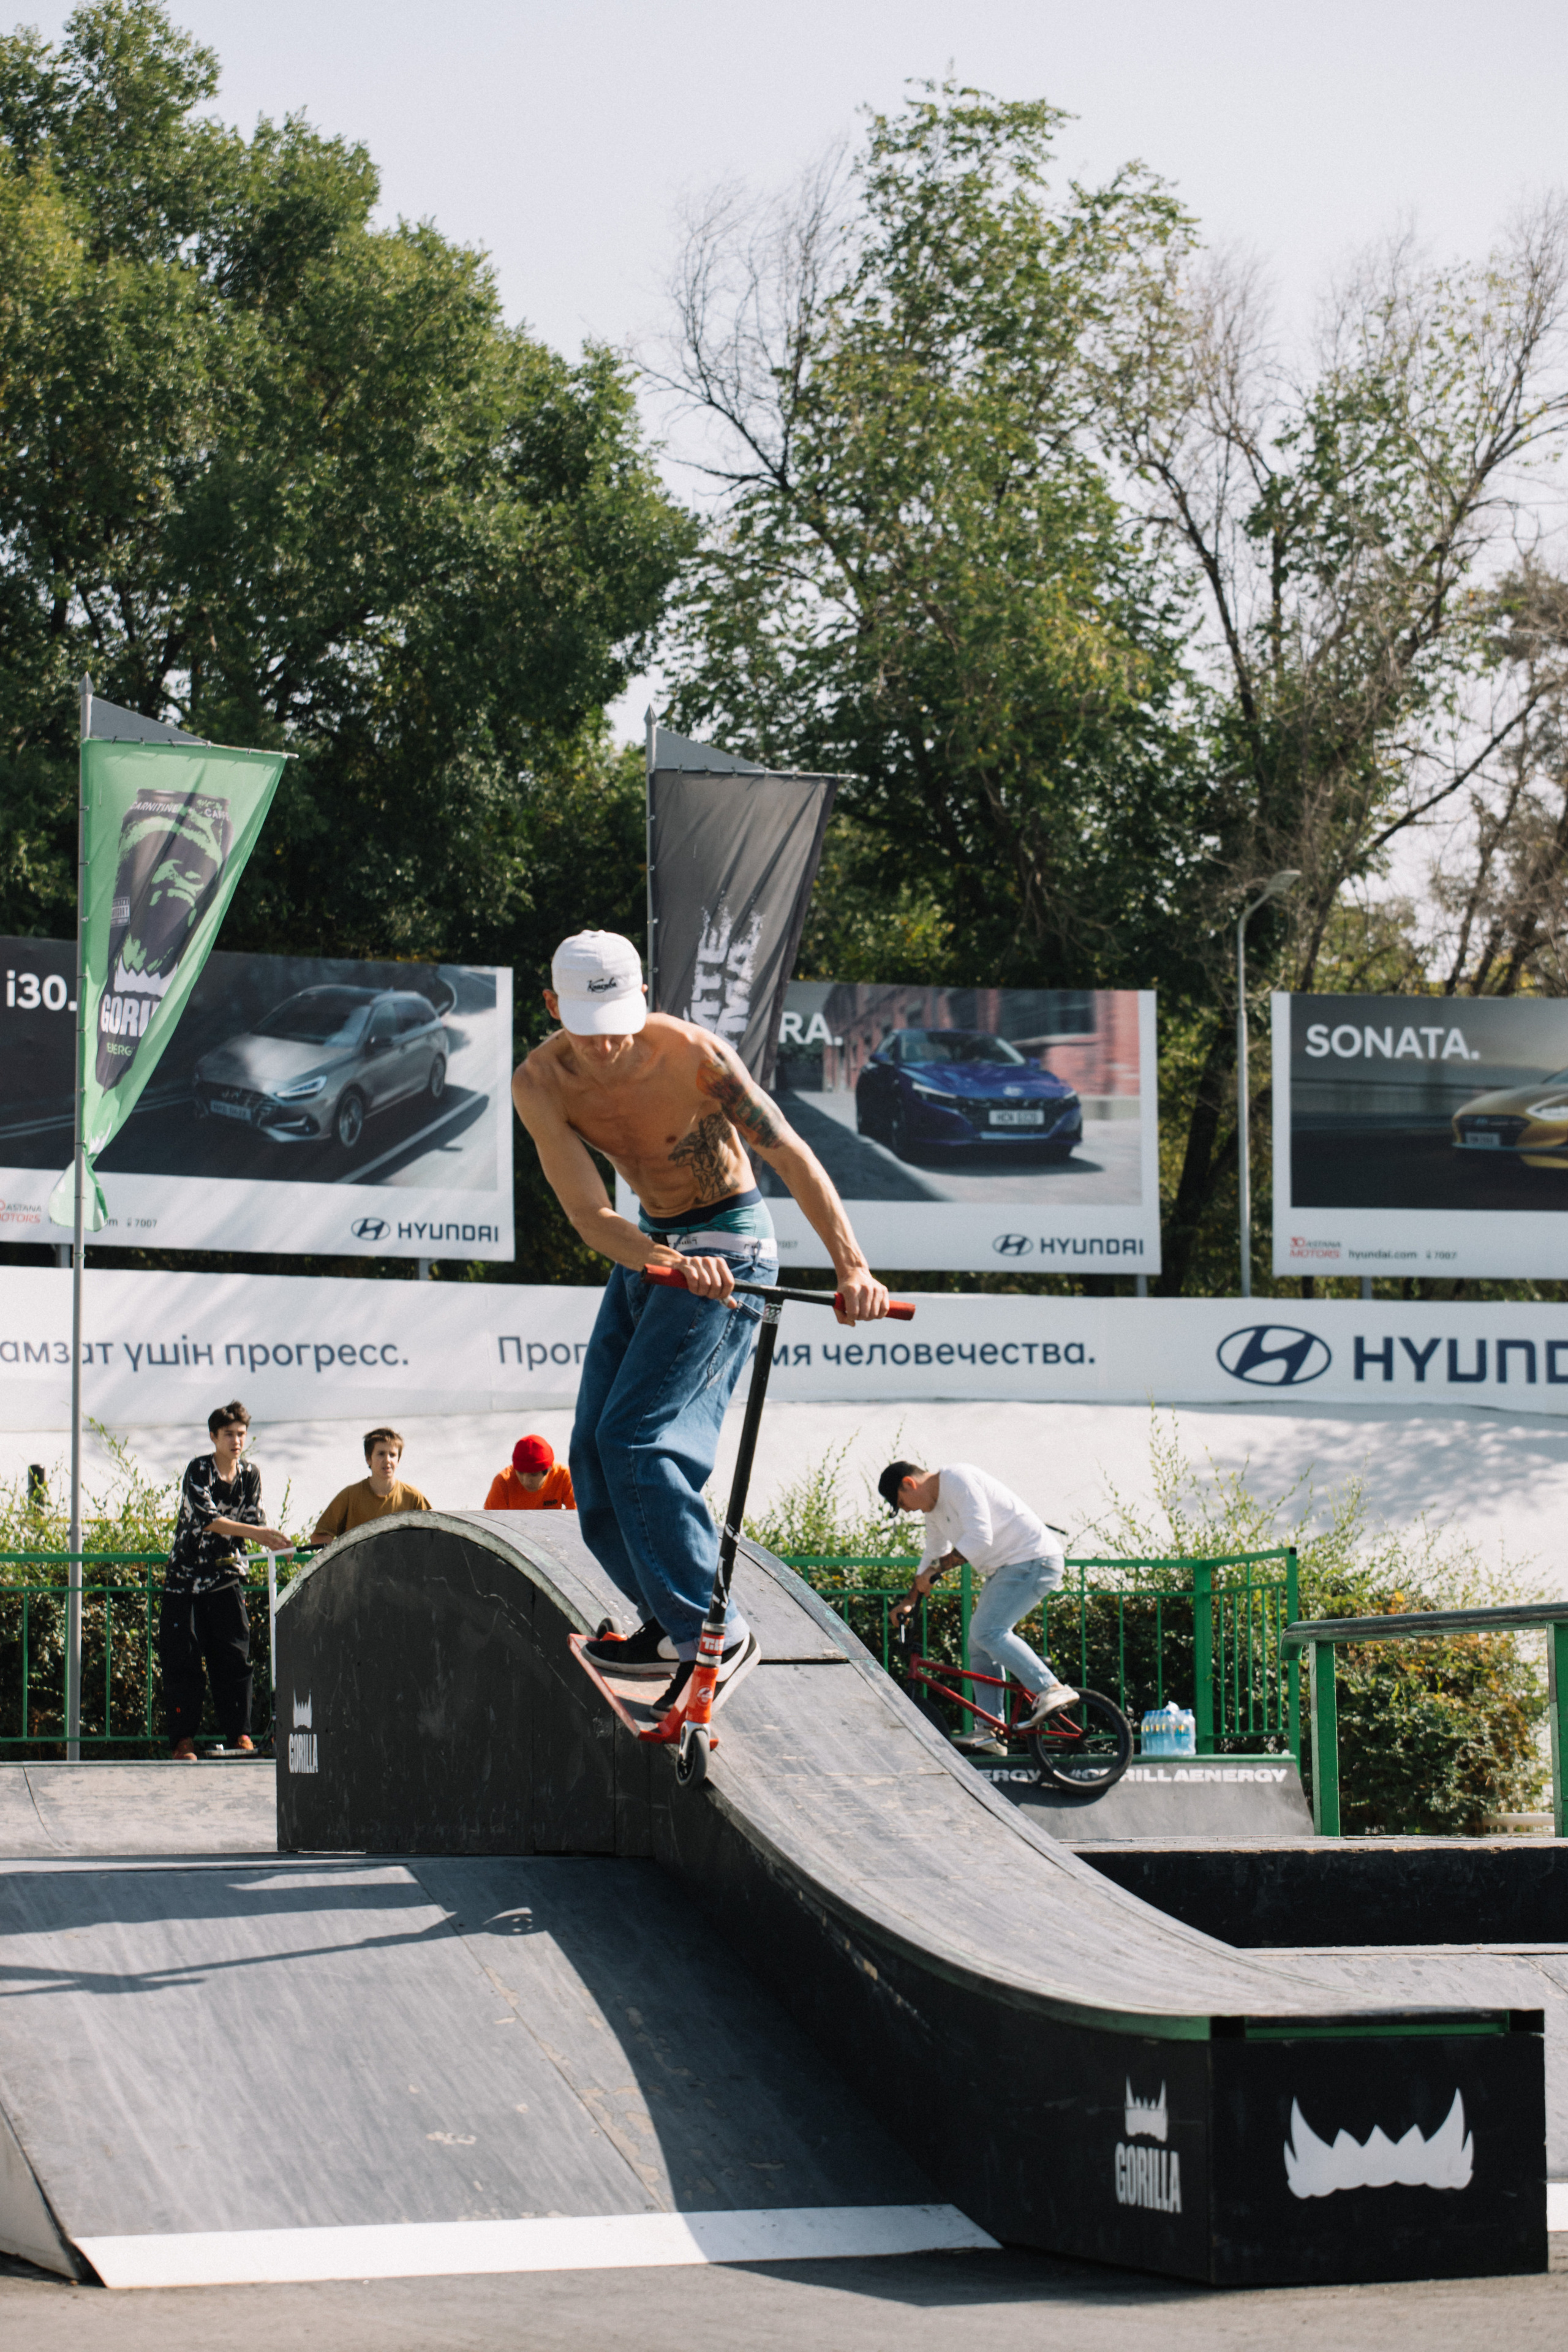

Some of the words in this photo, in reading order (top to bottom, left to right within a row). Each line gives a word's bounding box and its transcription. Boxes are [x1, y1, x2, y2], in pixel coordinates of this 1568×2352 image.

[683, 905, 734, 1035] ATE
[7, 970, 77, 1011] i30.
[778, 1011, 843, 1046] RA.
[1305, 1023, 1480, 1060] SONATA.
[0, 1213, 41, 1224] OTORS
[6, 1204, 42, 1212] ASTANA
[398, 1223, 498, 1242] HYUNDAI
[1041, 1237, 1144, 1254] HYUNDAI
[1290, 1249, 1340, 1259] MOTORS
[1348, 1249, 1418, 1260] hyundai.com
[225, 1343, 409, 1373] прогресс.
[822, 1343, 1096, 1366] человечества.
[288, 1727, 318, 1774] GORILLA
[1115, 2141, 1182, 2214] GORILLA
